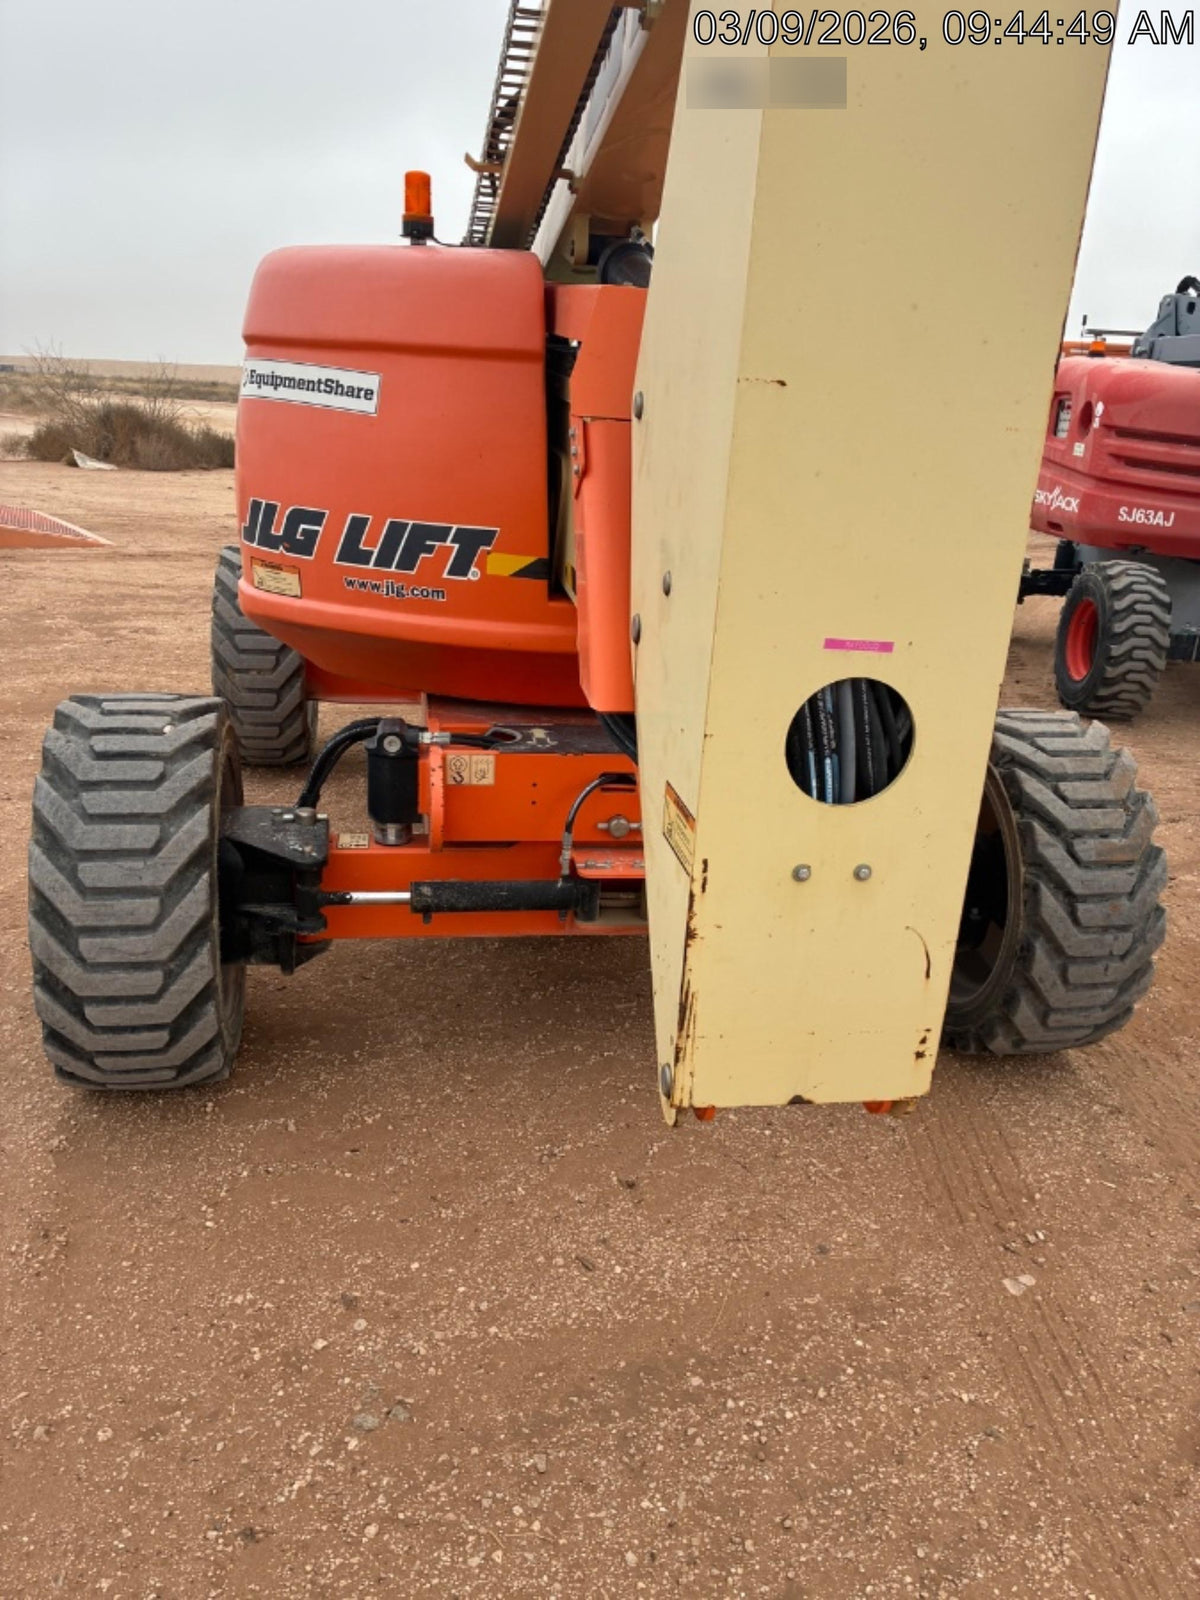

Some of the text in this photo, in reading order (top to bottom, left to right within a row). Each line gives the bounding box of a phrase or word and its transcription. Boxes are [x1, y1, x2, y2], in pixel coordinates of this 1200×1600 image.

[249, 369, 374, 400] EquipmentShare
[242, 498, 329, 559] JLG
[1118, 506, 1175, 527] SJ63AJ
[344, 576, 446, 600] www.jlg.com
